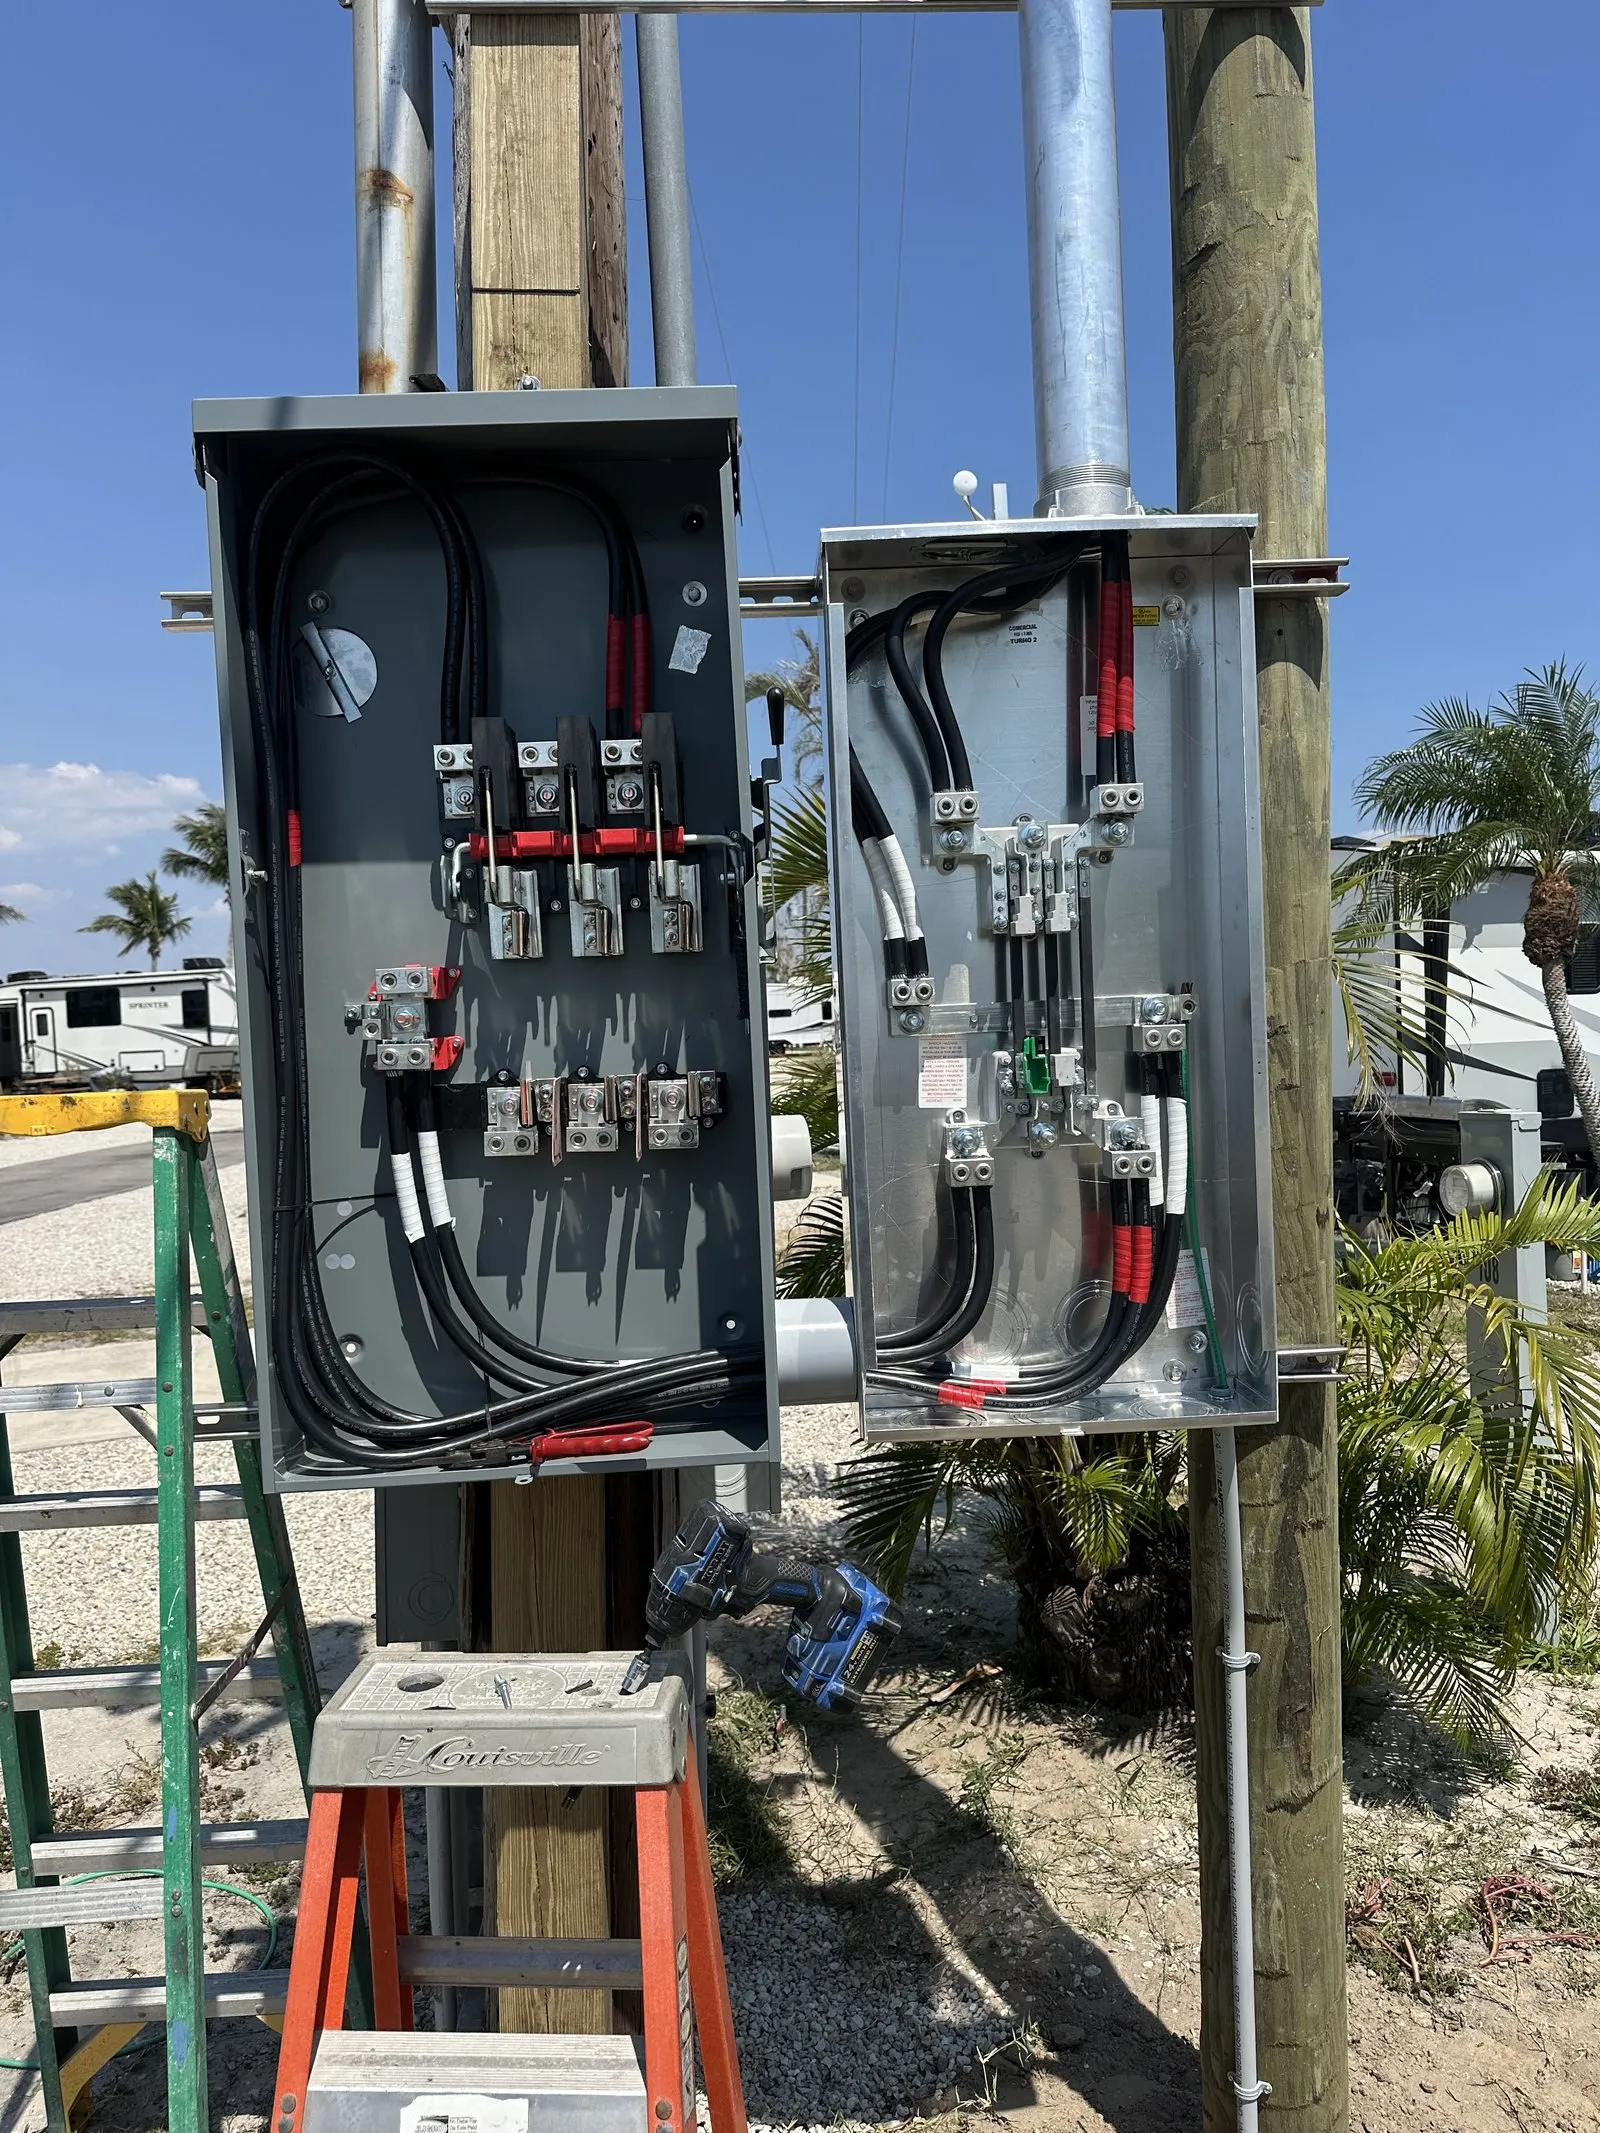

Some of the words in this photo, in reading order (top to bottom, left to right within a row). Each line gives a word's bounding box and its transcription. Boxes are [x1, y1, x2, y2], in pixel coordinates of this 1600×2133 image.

[128, 1001, 169, 1010] SPRINTER
[1480, 1257, 1500, 1284] 108
[850, 1648, 871, 1684] EXTENDED
[420, 1736, 602, 1775] Louisville
